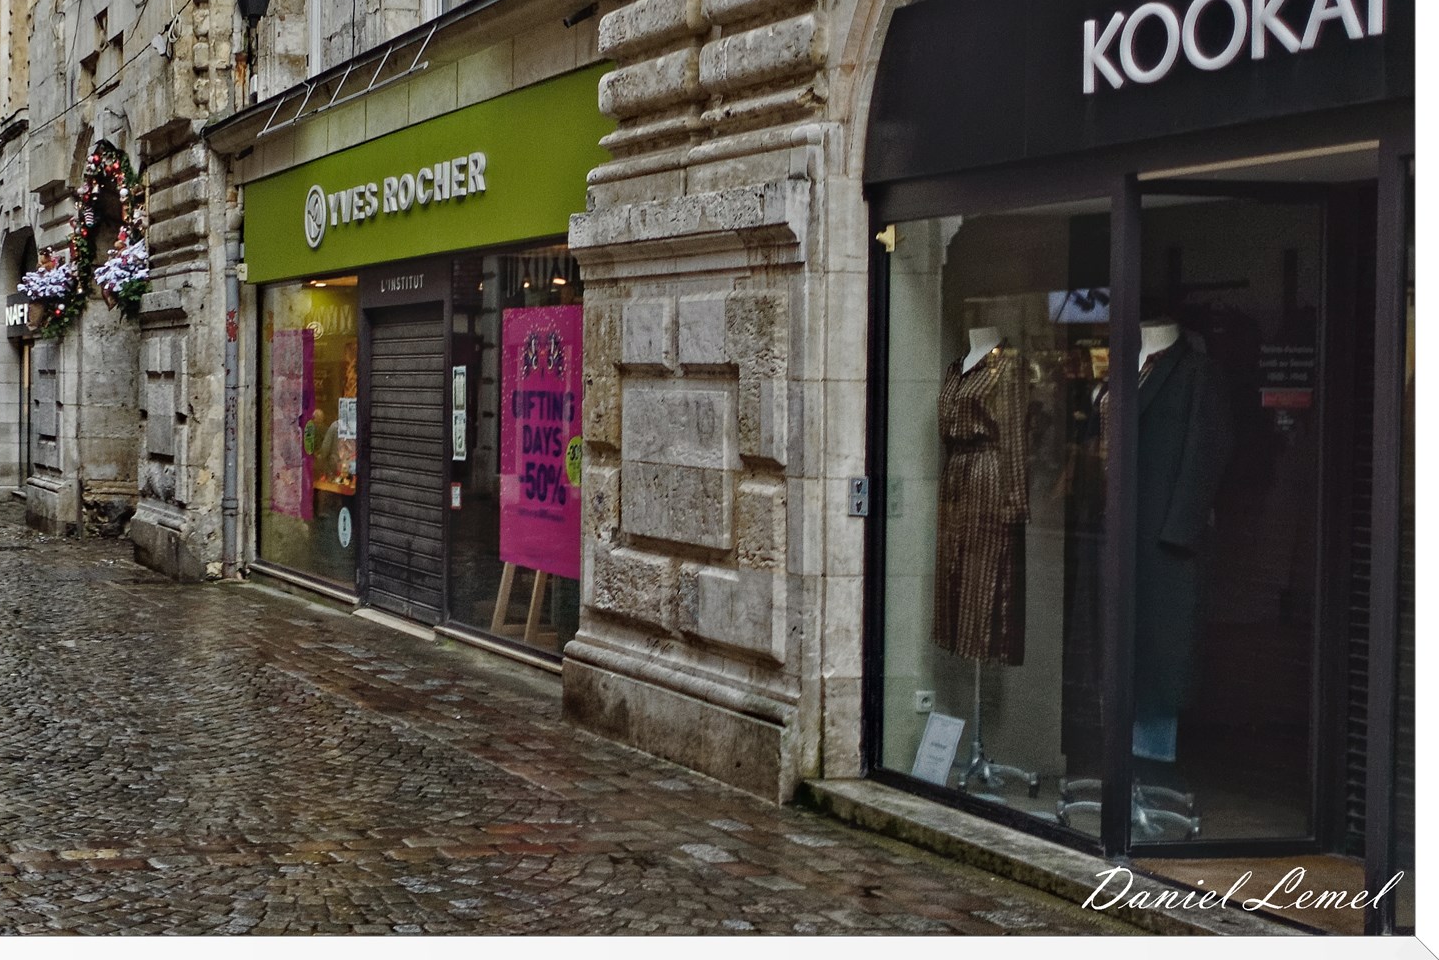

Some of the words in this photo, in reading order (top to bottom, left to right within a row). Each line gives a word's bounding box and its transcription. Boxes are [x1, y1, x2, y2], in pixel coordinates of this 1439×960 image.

[327, 182, 379, 227] YVES
[383, 151, 487, 214] ROCHER
[380, 273, 425, 293] L'INSTITUT
[511, 390, 575, 423] GIFTING
[522, 424, 563, 458] DAYS
[518, 462, 567, 506] -50%
